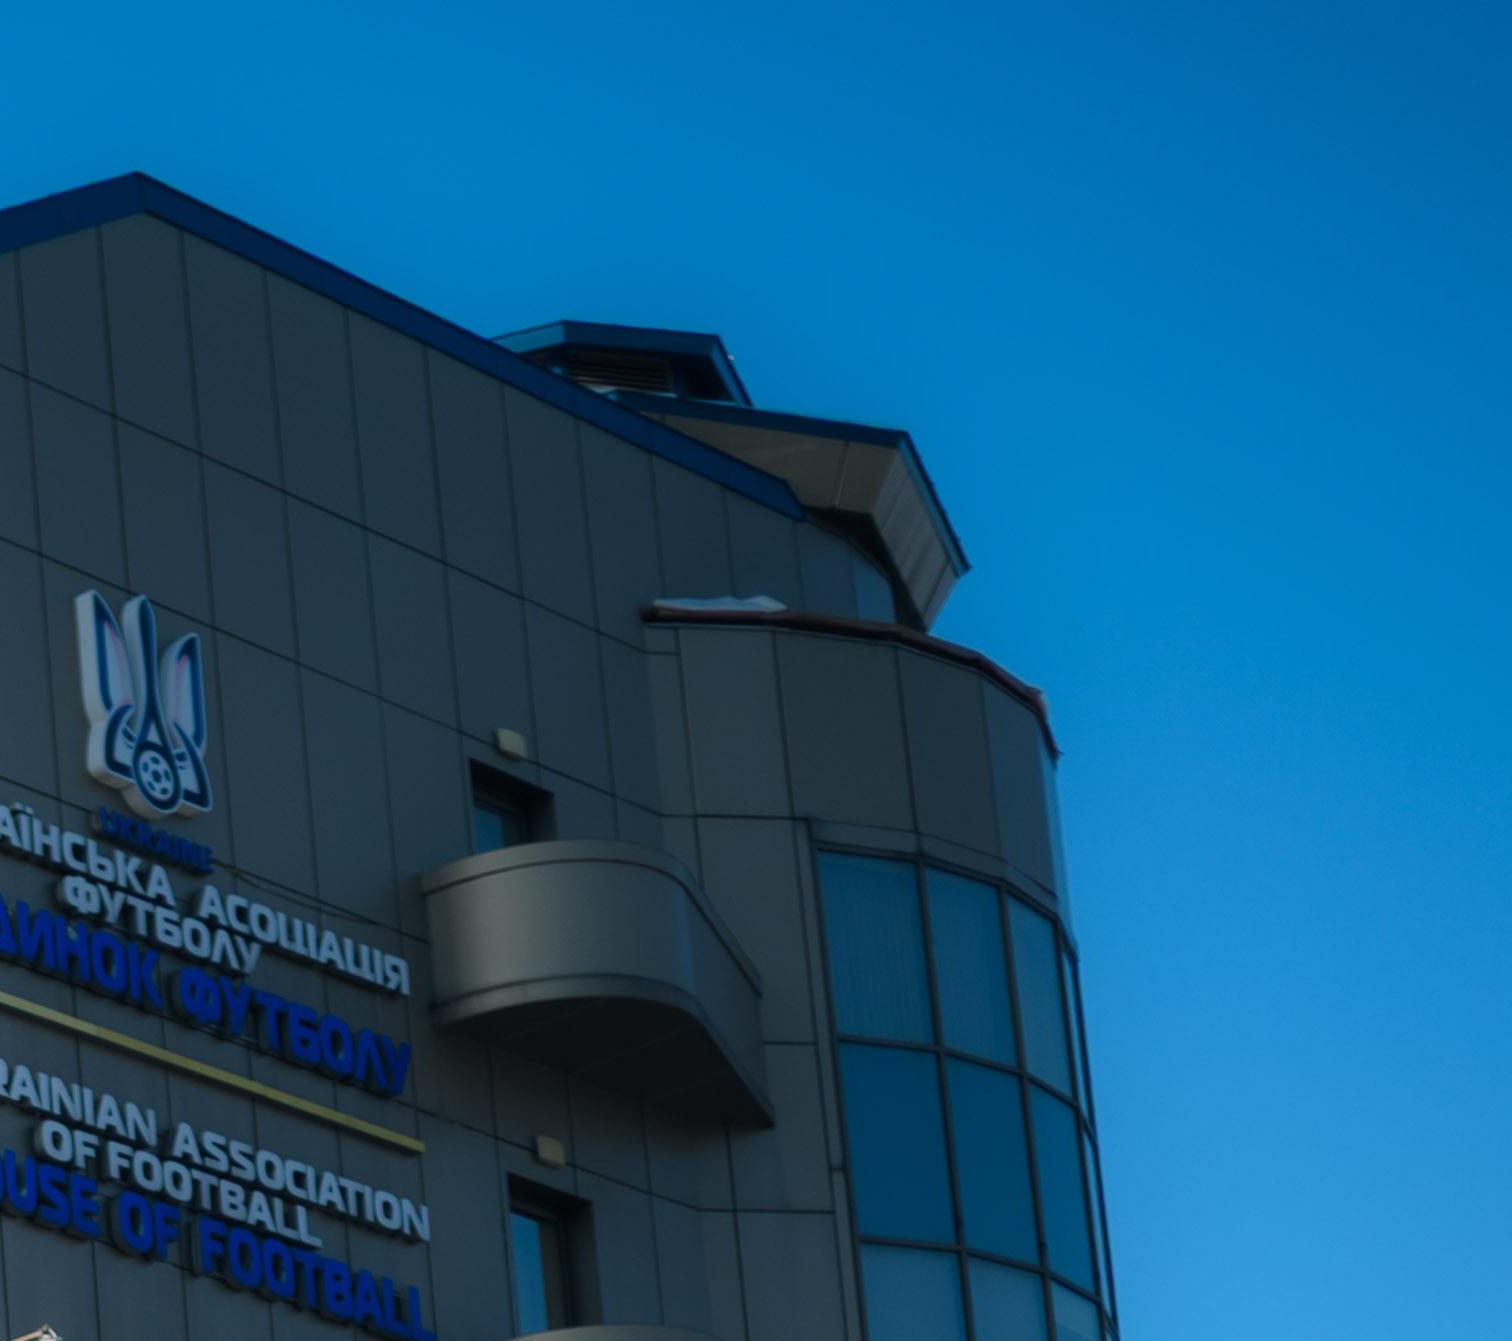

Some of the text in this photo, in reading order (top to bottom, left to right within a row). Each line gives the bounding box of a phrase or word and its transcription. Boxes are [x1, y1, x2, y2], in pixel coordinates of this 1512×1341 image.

[96, 807, 214, 874] UKRAINE
[60, 872, 261, 976] ФУТБОЛУ
[197, 885, 410, 997] АСОЦІАЦІЯ
[177, 966, 412, 1096] ФУТБОЛУ
[37, 1117, 323, 1249] OF FOOTBALL
[116, 1190, 180, 1264] OF
[171, 1121, 431, 1243] ASSOCIATION
